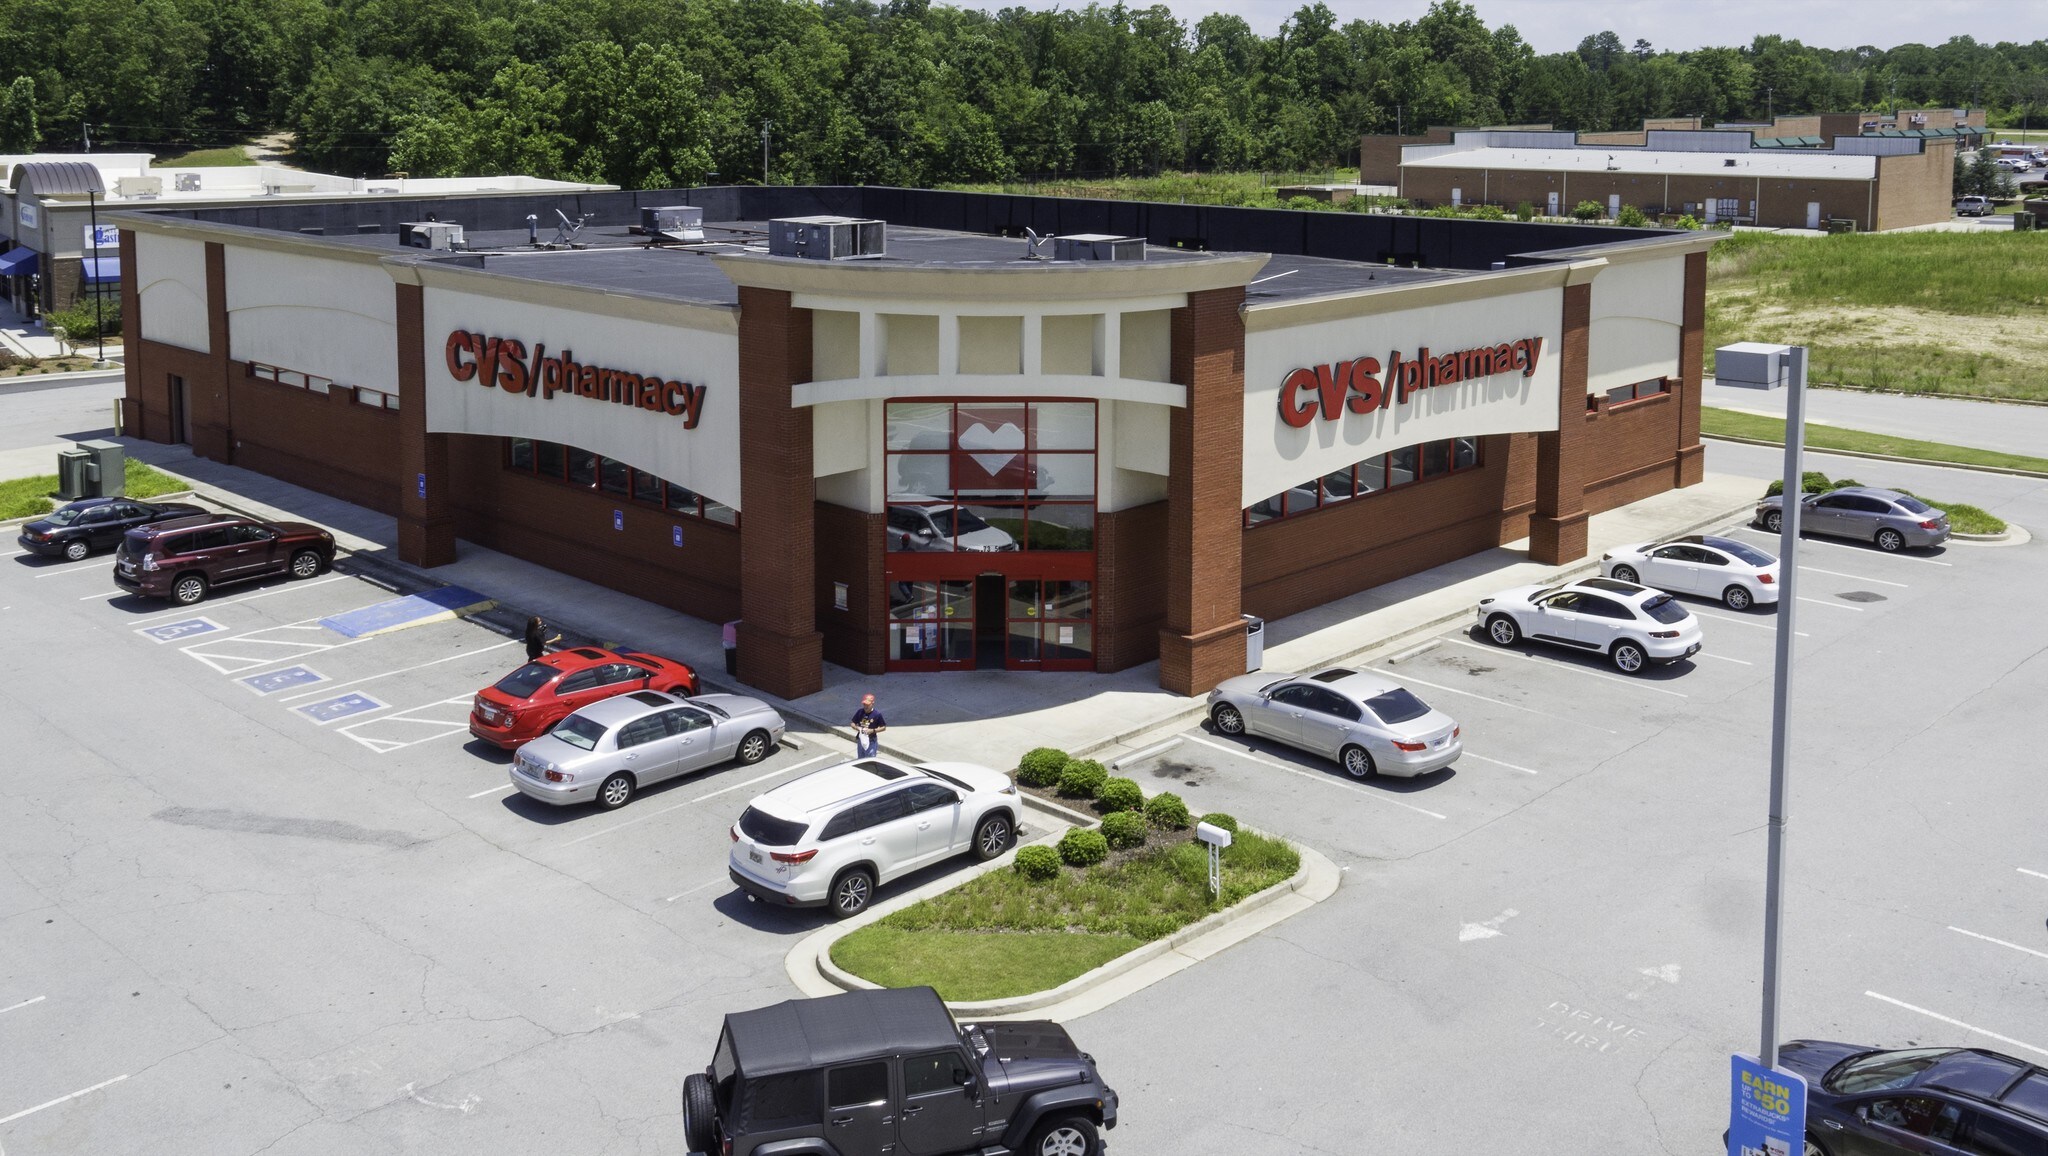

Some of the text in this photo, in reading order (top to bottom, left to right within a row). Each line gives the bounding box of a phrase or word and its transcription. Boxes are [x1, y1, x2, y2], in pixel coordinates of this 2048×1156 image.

[446, 330, 706, 430] CVS/pharmacy
[1278, 336, 1543, 428] CVS/pharmacy
[1741, 1070, 1790, 1100] EARN
[1741, 1083, 1752, 1092] UP
[1741, 1090, 1752, 1099] TO
[1753, 1089, 1790, 1115] $50
